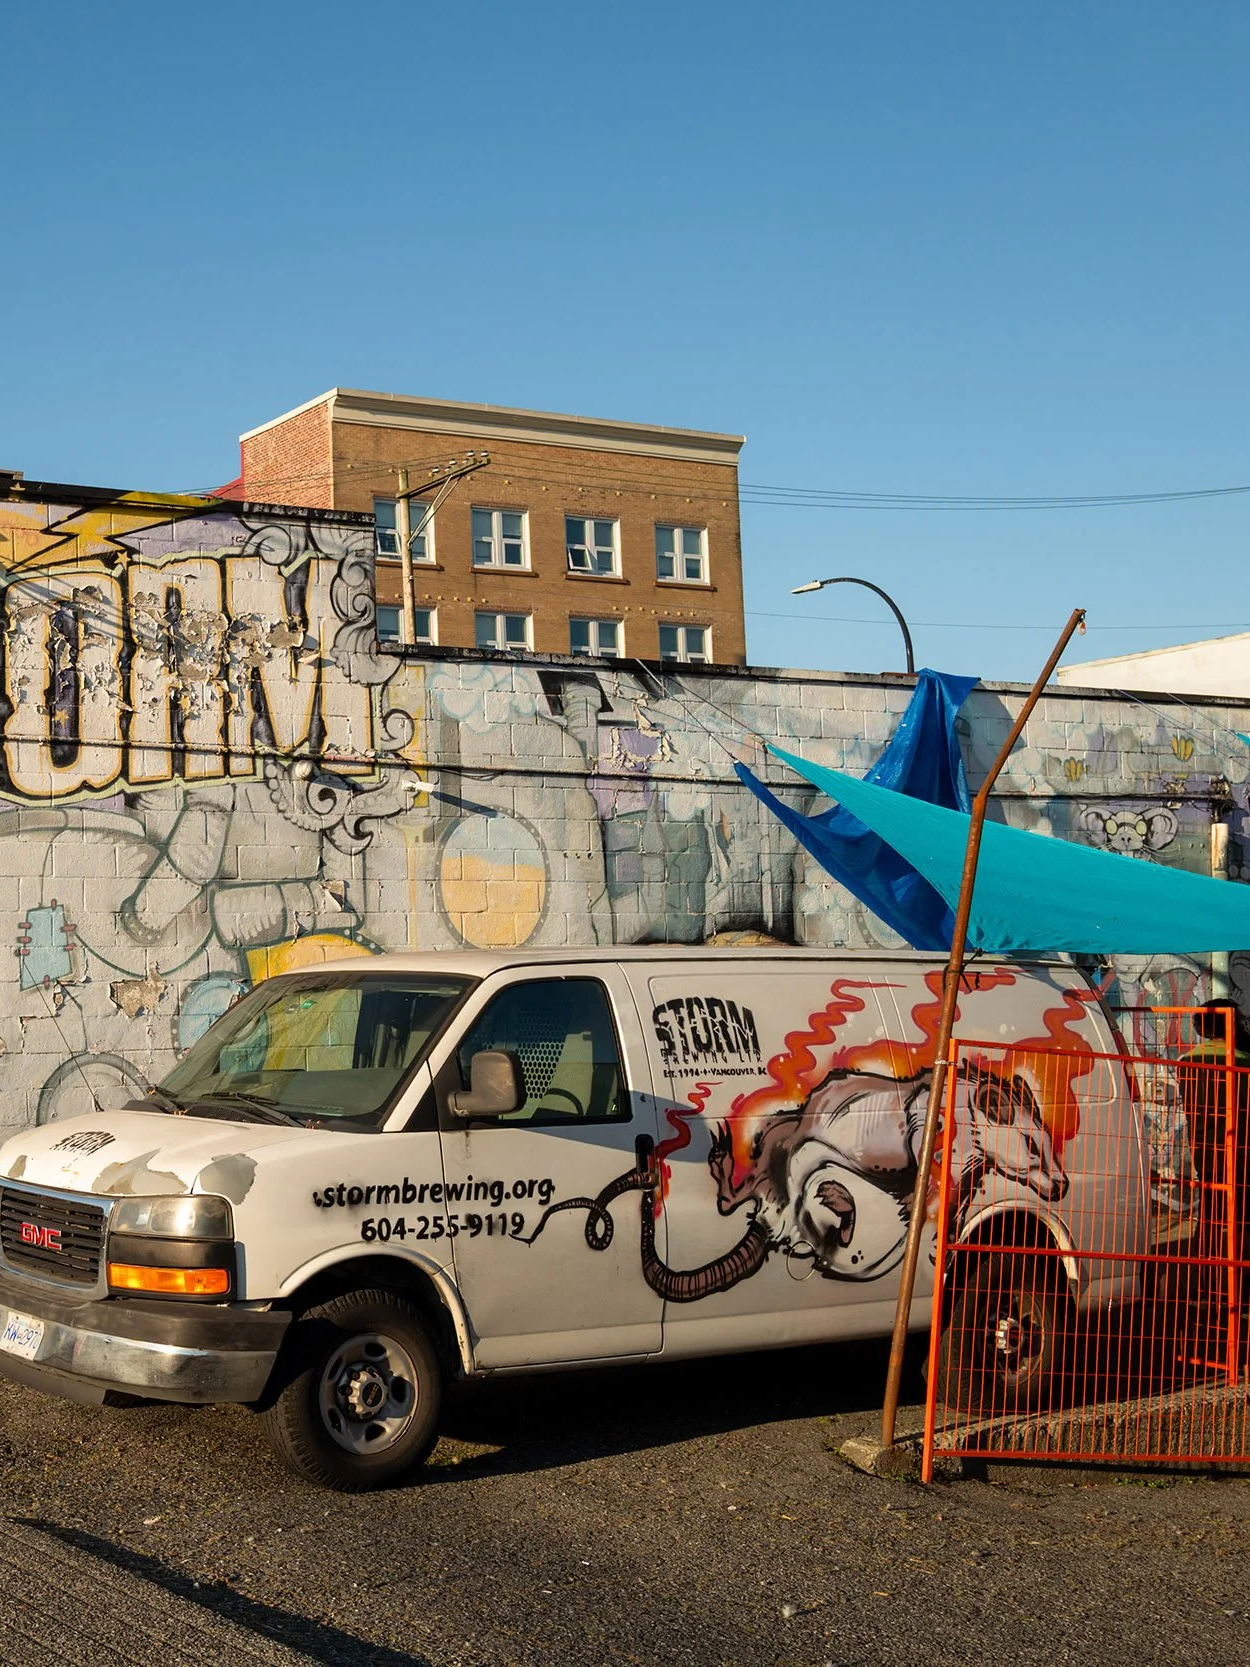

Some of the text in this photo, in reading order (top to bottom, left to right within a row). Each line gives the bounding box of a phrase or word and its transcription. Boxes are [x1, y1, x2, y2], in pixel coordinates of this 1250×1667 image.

[652, 996, 761, 1057] STORM
[757, 1066, 767, 1075] BC
[320, 1175, 554, 1208] stormbrewing.org
[21, 1221, 62, 1251] GMC
[360, 1212, 526, 1243] 604-255-9119
